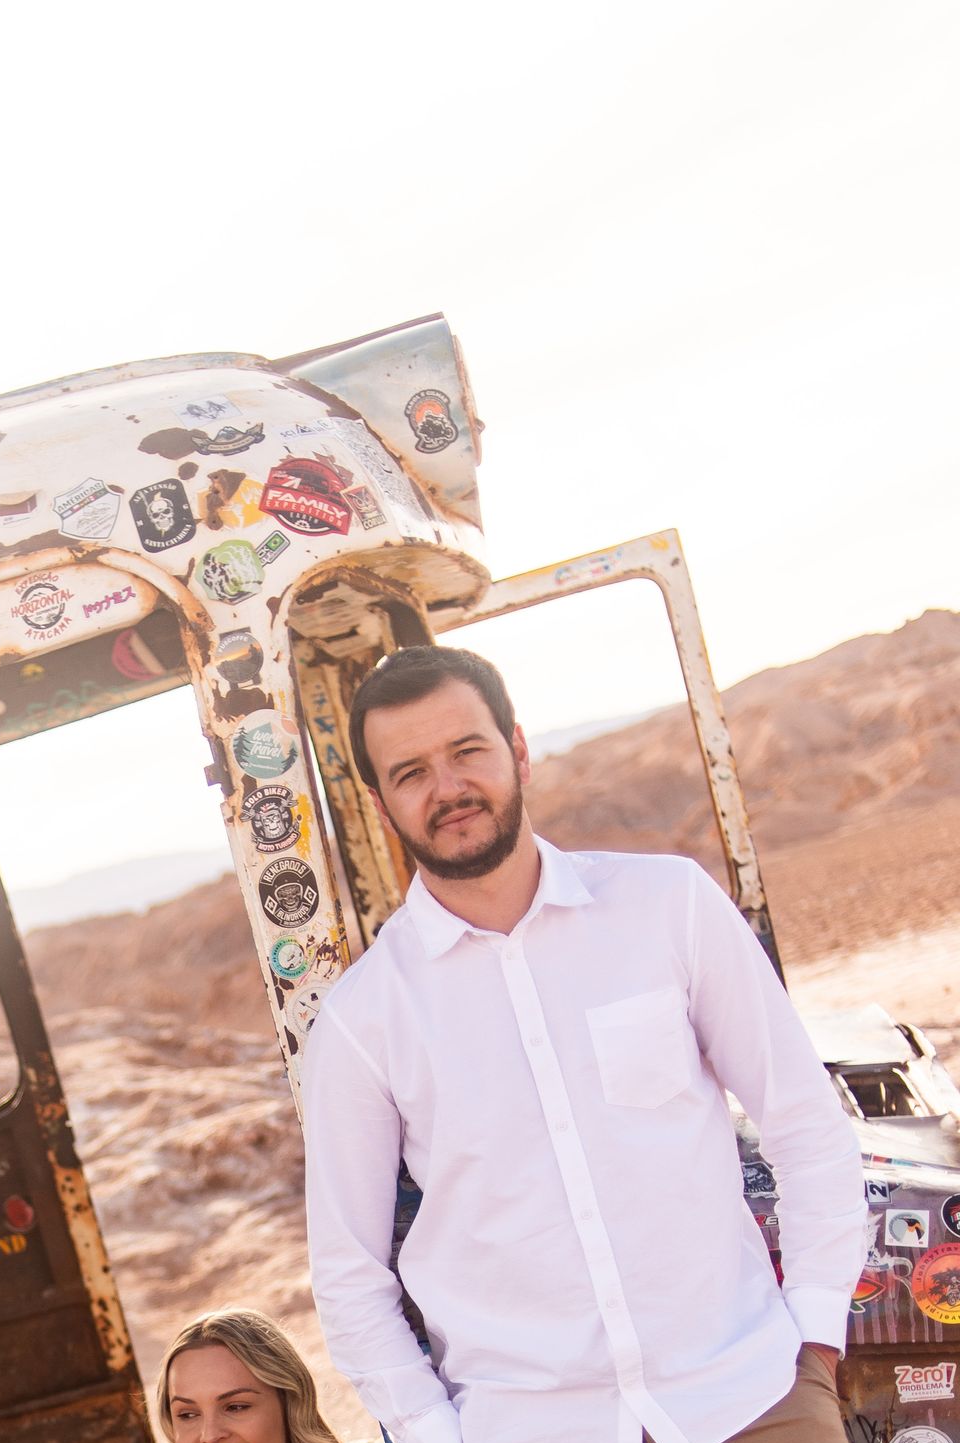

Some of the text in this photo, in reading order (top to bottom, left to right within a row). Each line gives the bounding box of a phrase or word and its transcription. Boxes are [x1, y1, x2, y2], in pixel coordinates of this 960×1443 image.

[264, 500, 344, 528] EXPEDITION
[266, 489, 348, 518] FAMILY
[10, 588, 76, 620] HORIZONTAL
[23, 615, 74, 641] ATACAMA
[264, 787, 288, 797] BIKER
[262, 861, 307, 883] RENEGADOS
[900, 1383, 945, 1393] PROBLEMA
